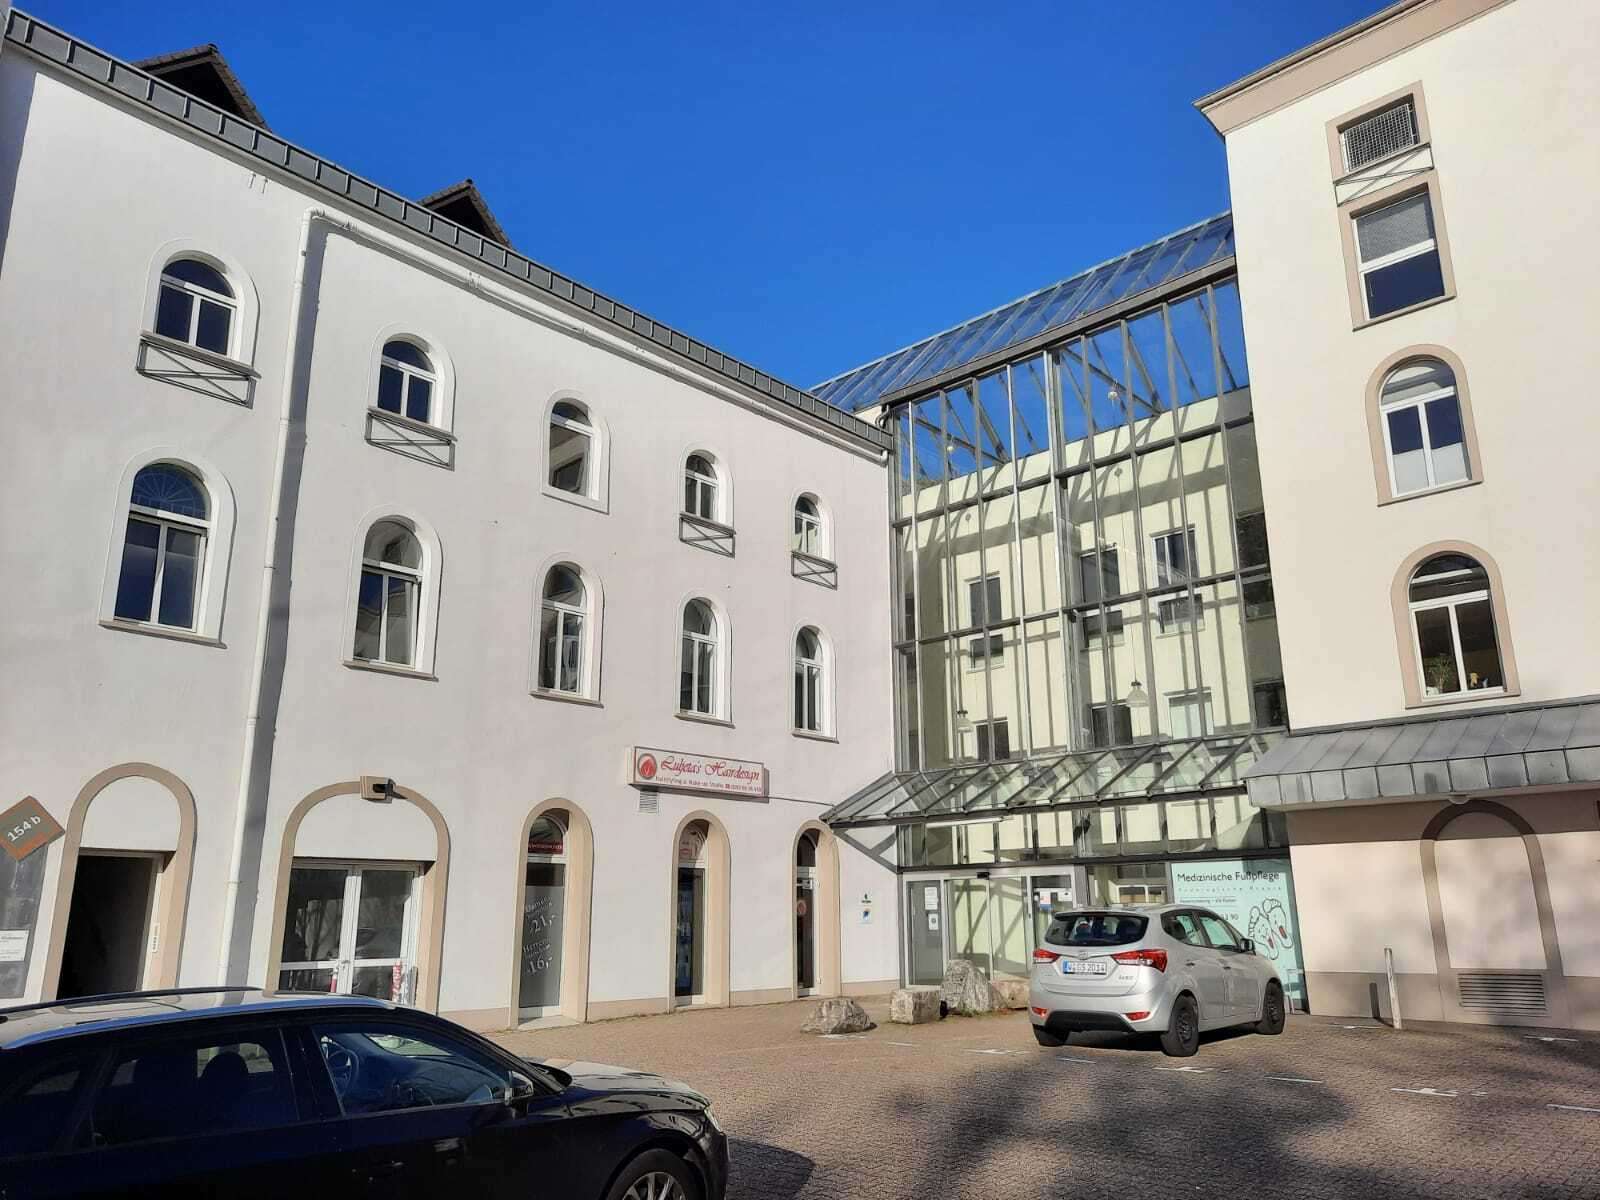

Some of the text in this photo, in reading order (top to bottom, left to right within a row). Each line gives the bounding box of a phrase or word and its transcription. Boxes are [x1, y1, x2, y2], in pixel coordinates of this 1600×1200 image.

[704, 761, 760, 784] Hairdesign
[7, 815, 41, 841] 154 b
[1177, 871, 1280, 883] Medizinische Fußpflege
